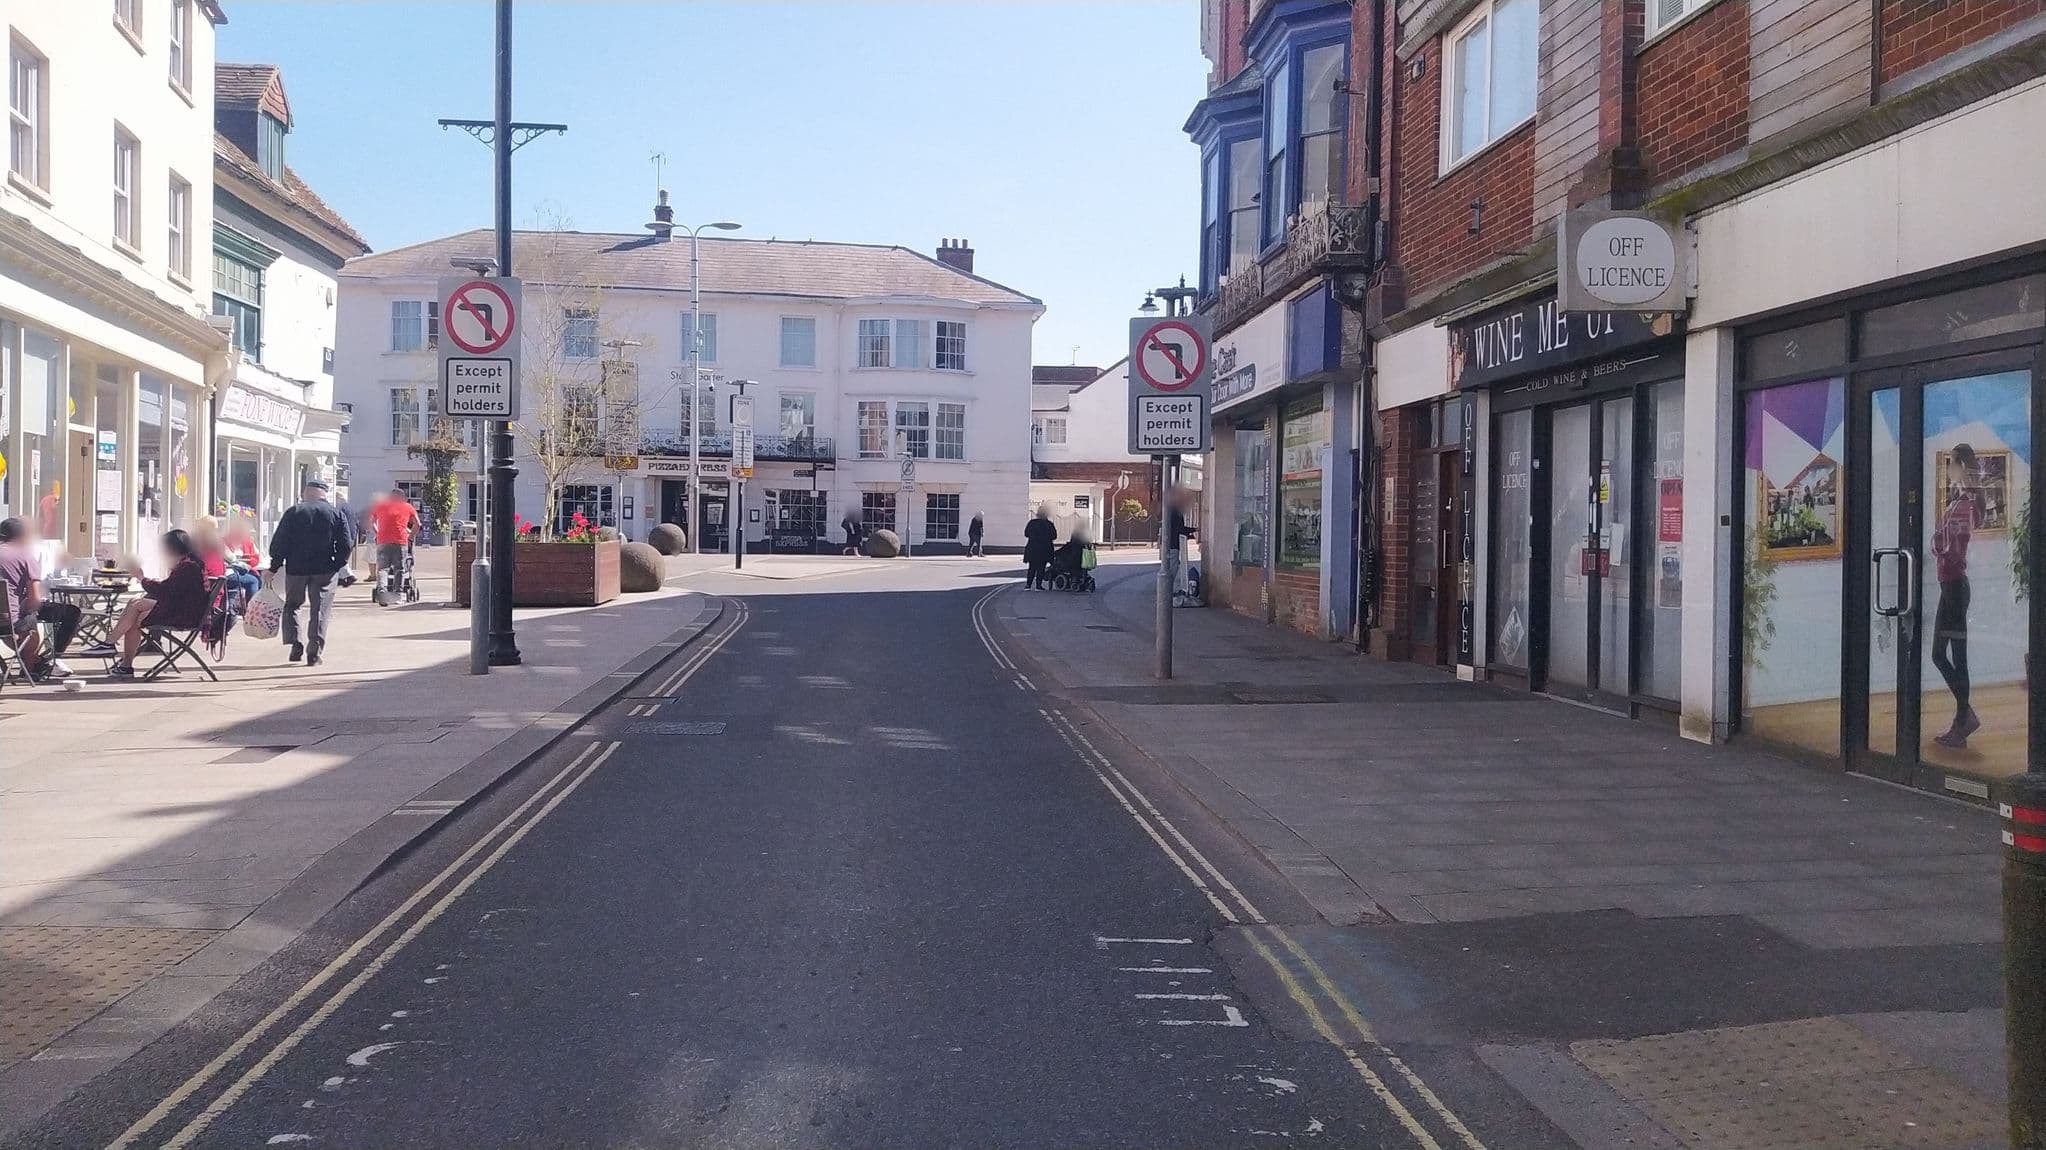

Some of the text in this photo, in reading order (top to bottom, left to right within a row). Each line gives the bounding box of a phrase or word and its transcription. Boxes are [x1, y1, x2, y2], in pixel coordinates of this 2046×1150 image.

[1609, 237, 1644, 256] OFF
[1588, 267, 1666, 287] LICENCE
[1473, 312, 1524, 370] WINE
[1537, 300, 1570, 354] ME
[455, 364, 503, 378] Except
[1526, 378, 1549, 392] COLD
[1553, 371, 1576, 385] WINE
[1593, 359, 1626, 377] BEERS
[456, 382, 502, 396] permit
[453, 399, 504, 411] holders
[1146, 402, 1192, 415] Except
[1146, 418, 1192, 431] permit
[1143, 434, 1195, 446] holders
[1663, 431, 1681, 449] OFF
[1508, 451, 1521, 466] OFF
[1502, 473, 1528, 489] LICENCE
[1461, 403, 1473, 653] OFF LICENCE
